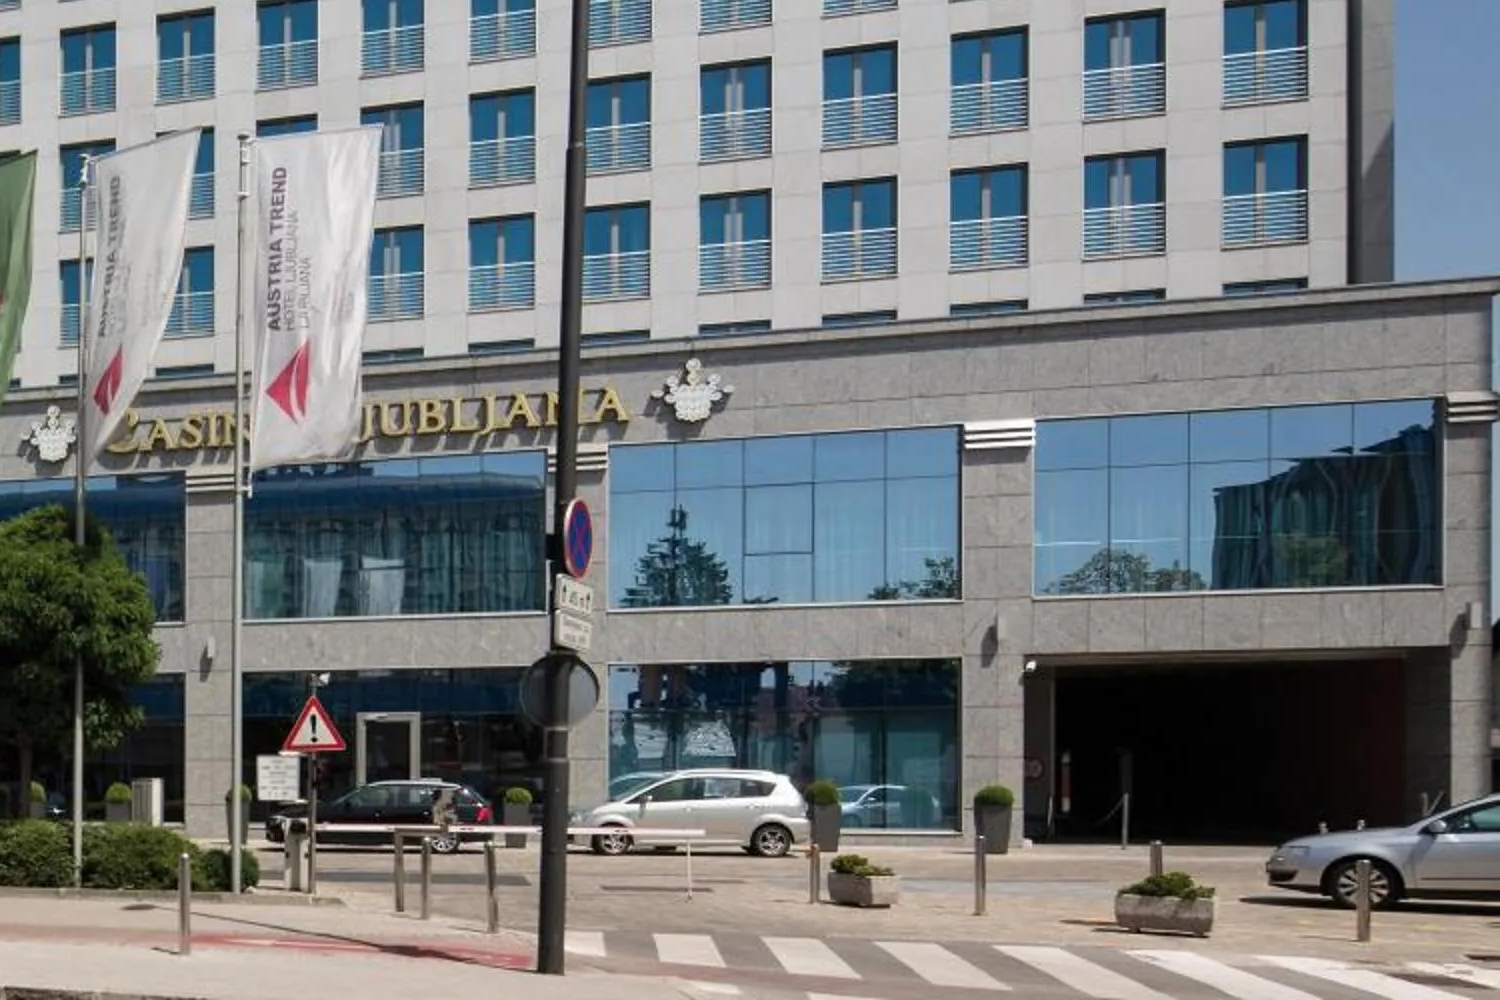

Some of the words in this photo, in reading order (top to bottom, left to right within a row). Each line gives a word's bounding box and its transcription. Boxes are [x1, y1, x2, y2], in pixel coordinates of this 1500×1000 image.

[269, 166, 288, 236] TREND
[267, 238, 284, 332] AUSTRIA
[103, 408, 252, 454] CASIN
[352, 380, 630, 445] JUBLJANA
